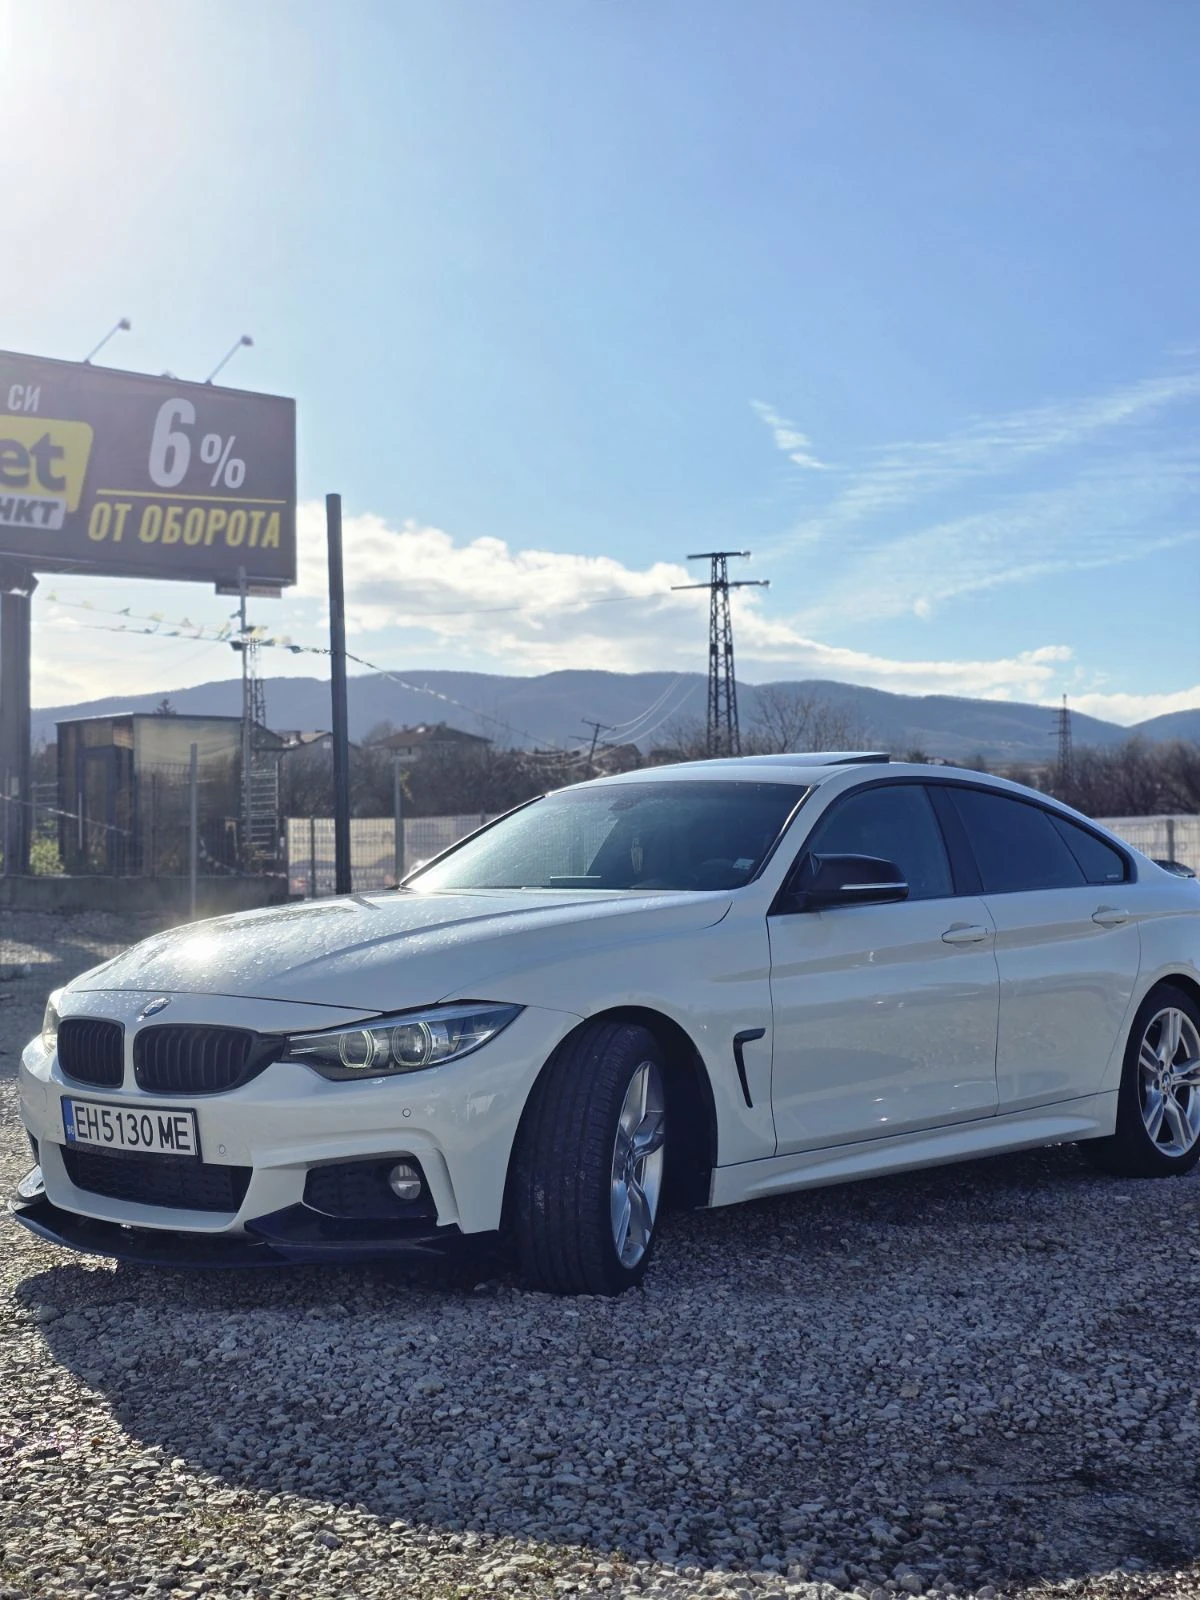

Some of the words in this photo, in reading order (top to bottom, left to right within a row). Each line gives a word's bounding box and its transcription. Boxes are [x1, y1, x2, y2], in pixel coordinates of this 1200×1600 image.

[7, 384, 41, 412] СИ
[88, 502, 132, 542] ОТ
[138, 504, 280, 548] ОБОРОТА
